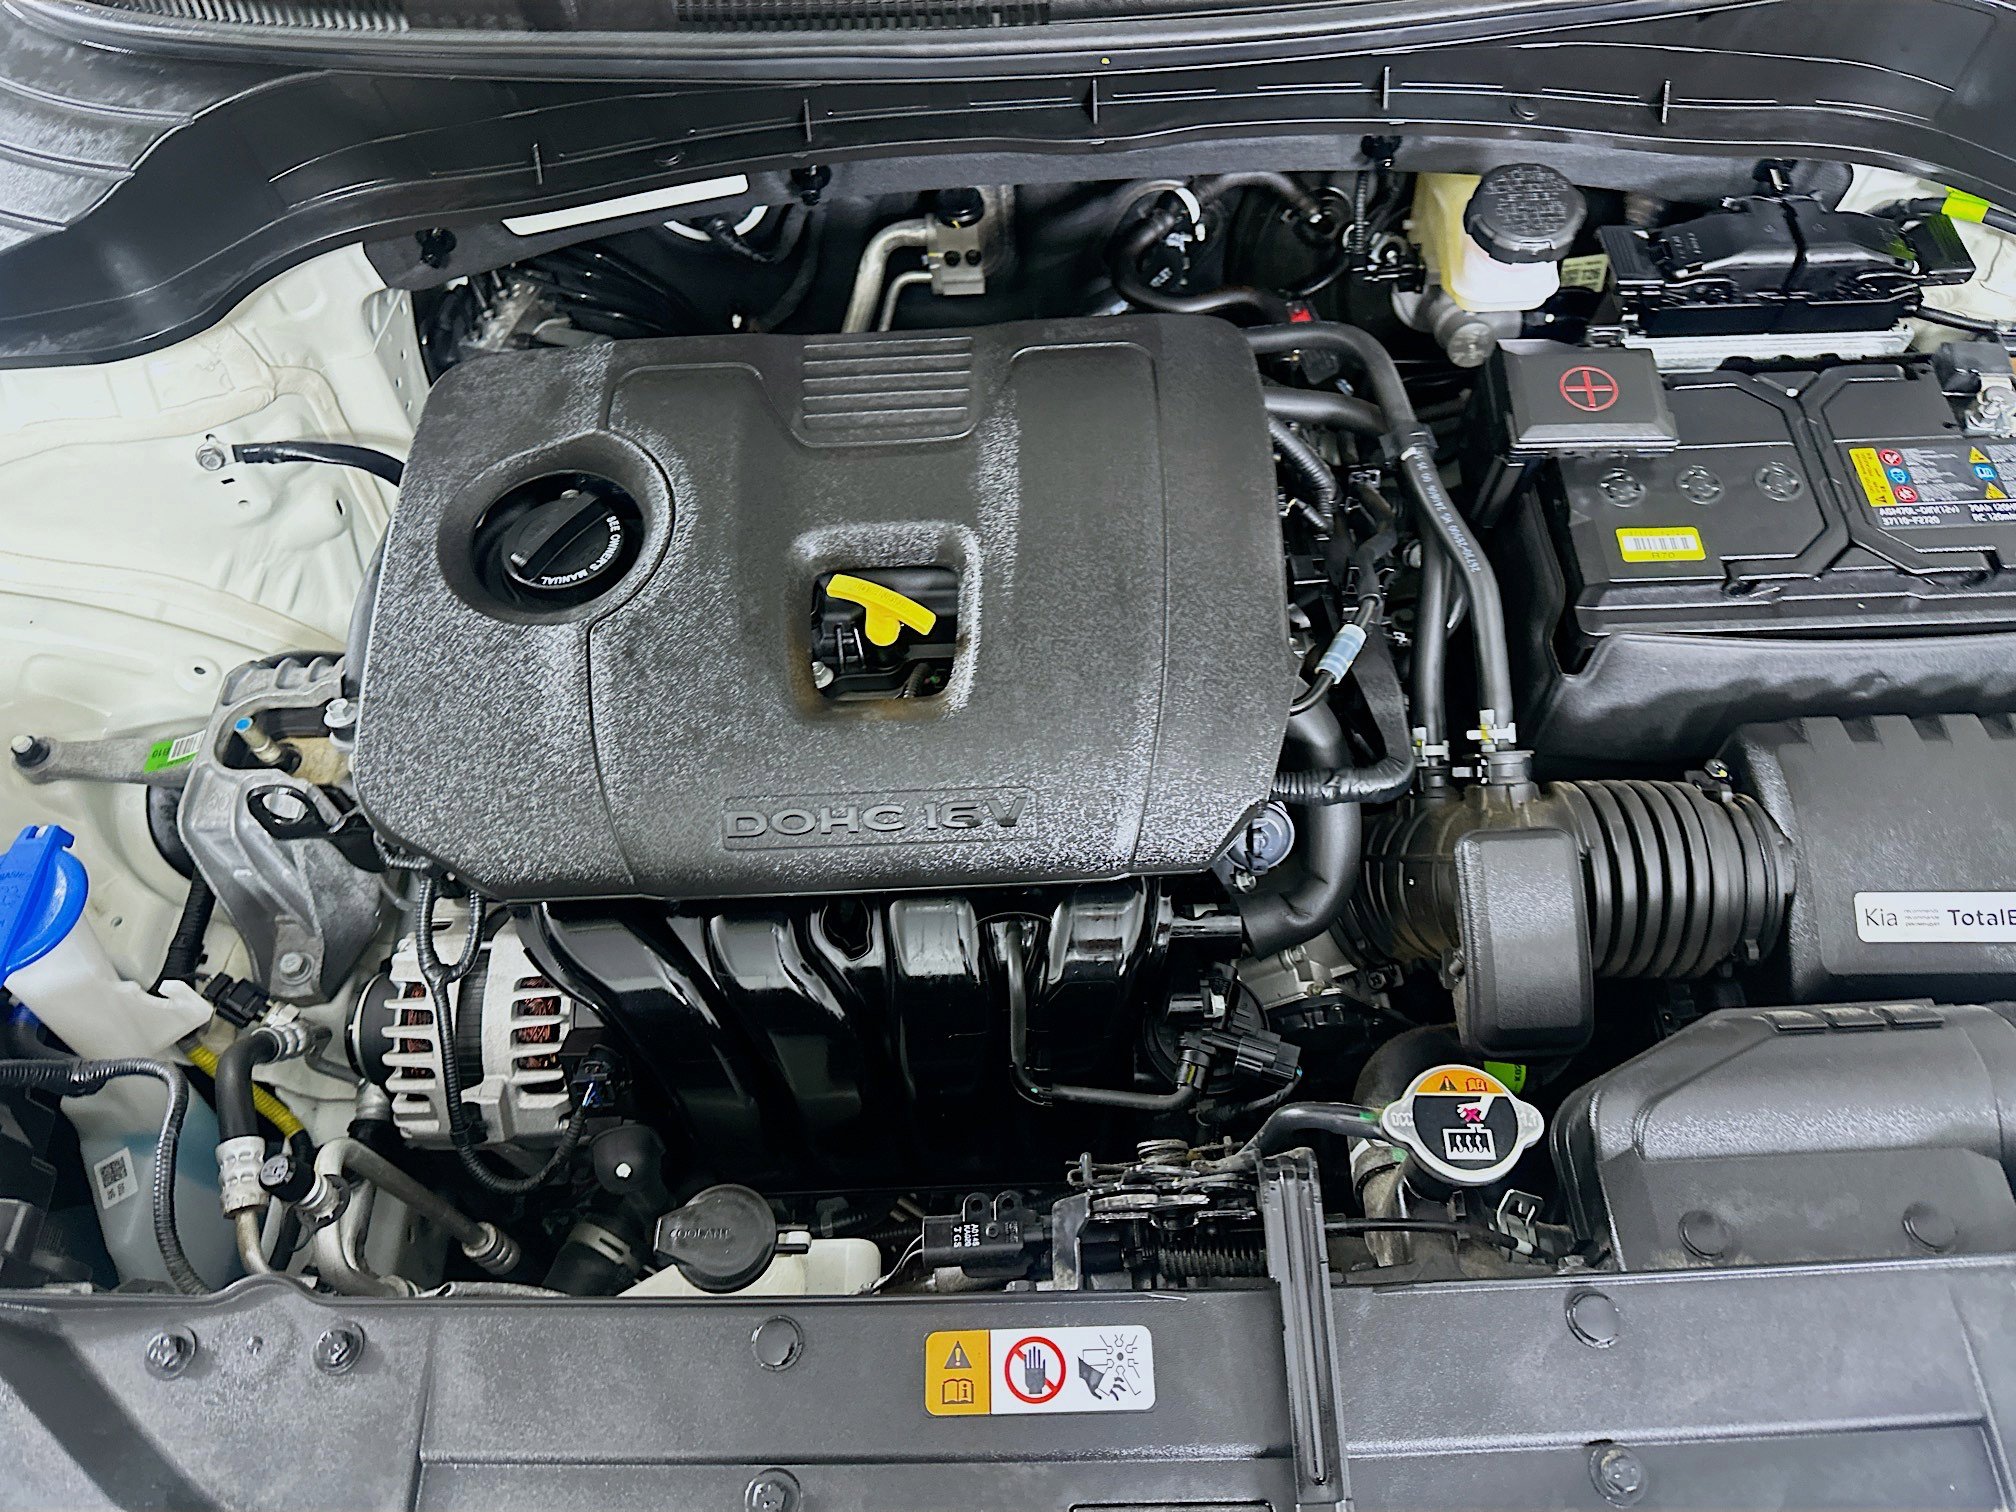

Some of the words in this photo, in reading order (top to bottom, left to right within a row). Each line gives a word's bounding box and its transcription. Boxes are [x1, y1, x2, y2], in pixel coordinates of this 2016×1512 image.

[606, 515, 621, 533] SEE
[541, 568, 589, 585] MANUAL
[726, 804, 906, 839] DOHC
[923, 798, 1028, 831] 16V
[1864, 908, 1899, 927] Kia
